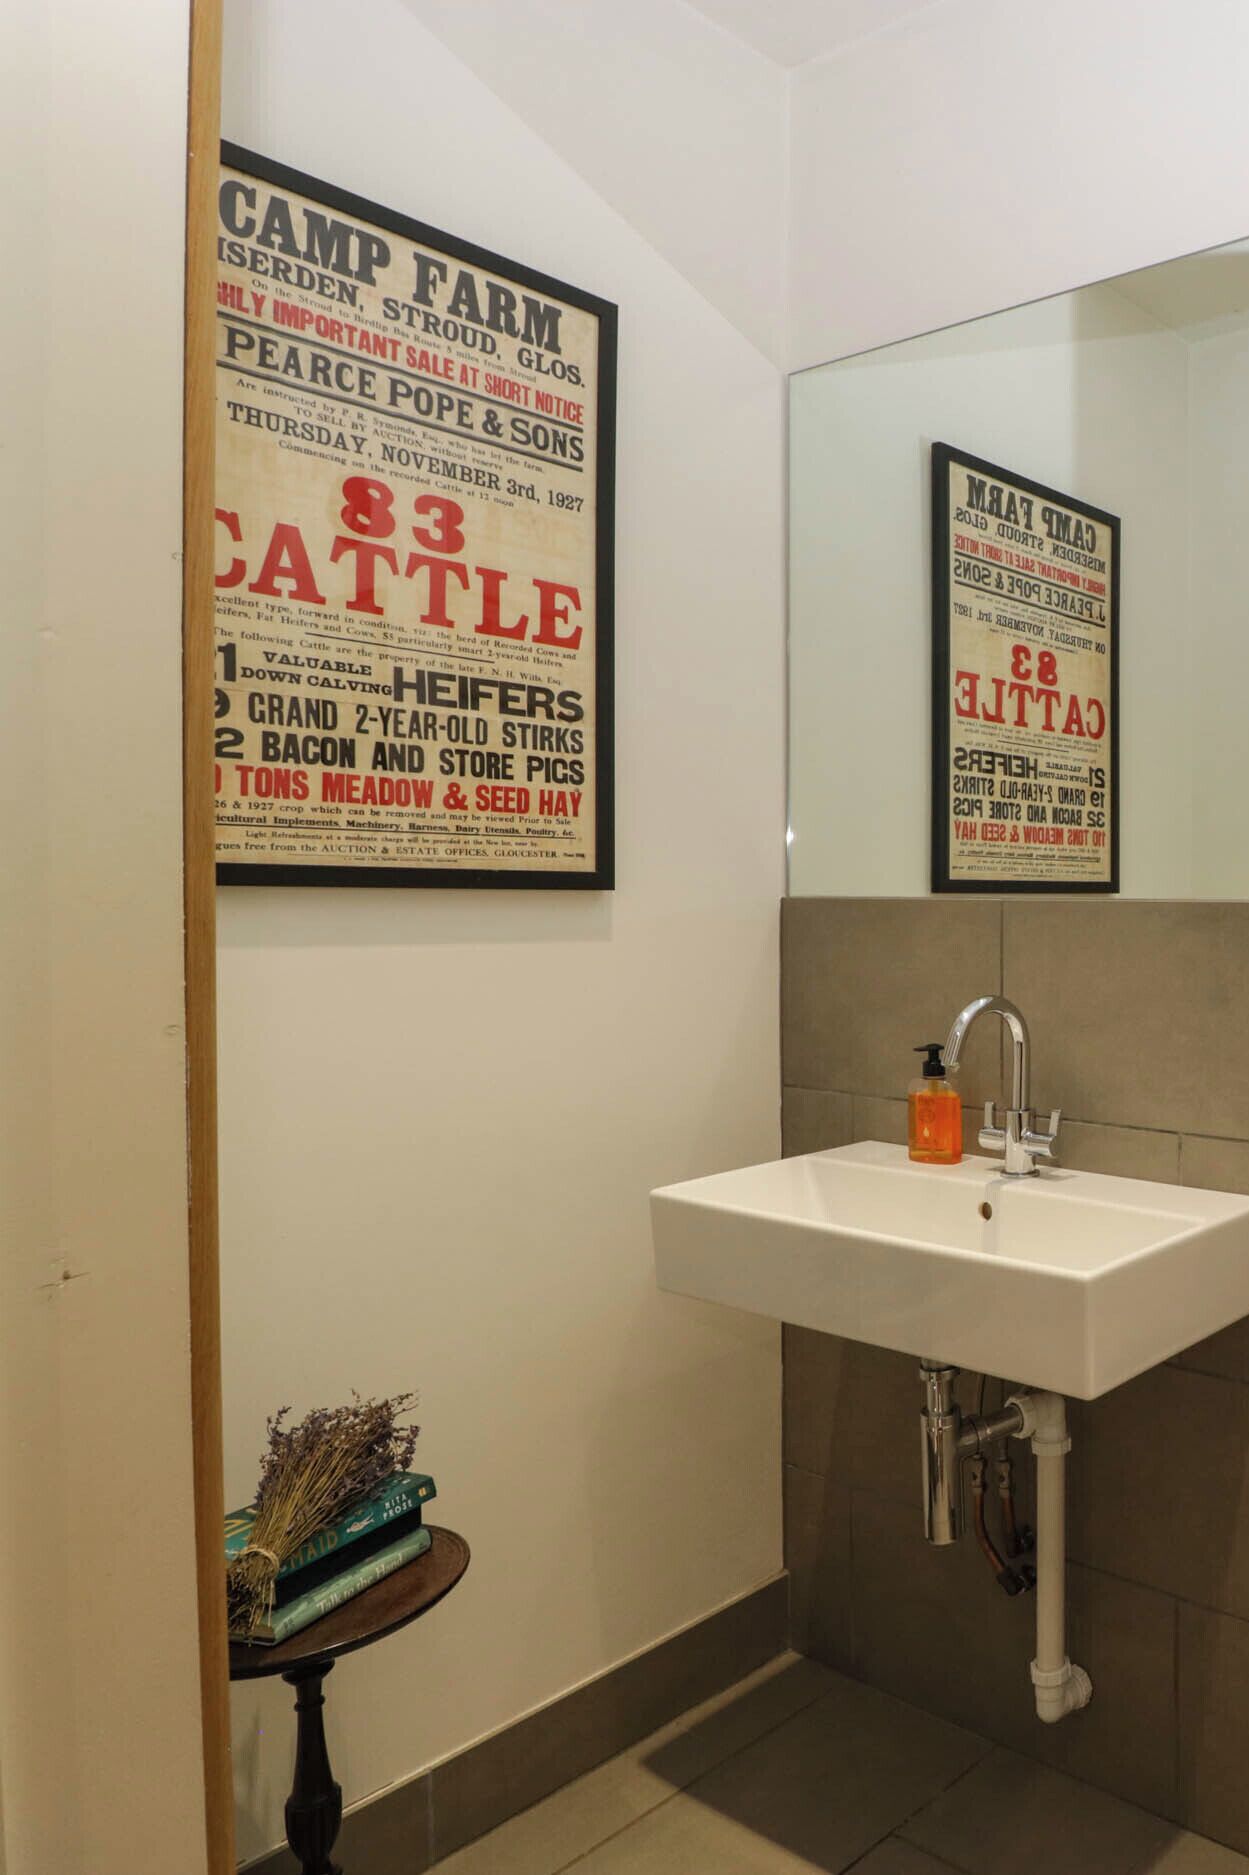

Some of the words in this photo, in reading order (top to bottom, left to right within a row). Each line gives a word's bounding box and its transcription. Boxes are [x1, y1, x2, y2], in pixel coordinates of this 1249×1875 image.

[219, 179, 391, 287] CAMP
[412, 250, 563, 355] FARM
[273, 299, 401, 362] IMPORTANT
[406, 345, 455, 381] SALE
[459, 364, 479, 389] AT
[485, 373, 531, 406] SHORT
[535, 390, 584, 425] NOTICE
[382, 297, 501, 360] STROUD,
[516, 347, 585, 389] GLOS.
[224, 325, 377, 400] PEARCE
[388, 376, 474, 429] POPE
[482, 409, 503, 438] &
[510, 417, 584, 462] SONS
[227, 401, 373, 458] THURSDAY,
[381, 443, 500, 491] NOVEMBER
[507, 479, 541, 504] 3rd,
[548, 490, 584, 512] 1927
[293, 406, 312, 418] TO
[318, 412, 345, 427] SELL
[351, 422, 367, 432] BY
[430, 445, 466, 461] without
[279, 439, 347, 466] Commencing
[371, 464, 385, 474] the
[390, 470, 431, 486] recorded
[435, 480, 463, 494] Cattle
[340, 476, 465, 554] 83
[215, 506, 584, 650] CATTLE
[241, 630, 293, 647] following
[300, 639, 330, 651] Cattle
[336, 645, 351, 654] are
[357, 646, 372, 657] the
[379, 652, 419, 665] property
[440, 660, 454, 671] the
[459, 664, 474, 673] late
[240, 667, 301, 685] DOWN
[307, 675, 392, 696] CALVING
[262, 651, 372, 676] VALUABLE
[393, 666, 584, 723] HEIFERS
[248, 692, 338, 732] GRAND
[355, 703, 489, 747] 2-YEAR-OLD
[502, 713, 584, 755] STIRKS
[261, 730, 356, 768] BACON
[371, 741, 424, 773] AND
[439, 748, 514, 780] STORE
[527, 755, 585, 785] PIGS
[233, 801, 242, 809] &
[248, 802, 274, 811] 1927
[280, 806, 304, 814] crop
[311, 806, 342, 815] which
[348, 808, 365, 816] can
[370, 809, 381, 817] be
[385, 810, 426, 819] removed
[431, 812, 446, 820] and
[450, 814, 468, 822] may
[519, 816, 540, 824] Prior
[235, 765, 309, 800] TONS
[322, 772, 434, 809] MEADOW
[443, 782, 469, 811] &
[475, 784, 530, 815] SEED
[539, 789, 582, 817] HAY
[244, 842, 266, 850] free
[271, 843, 296, 851] from
[301, 844, 317, 852] the
[321, 845, 377, 854] AUCTION
[396, 847, 439, 855] ESTATE
[456, 825, 480, 833] Dairy
[383, 1500, 413, 1520] PROSE
